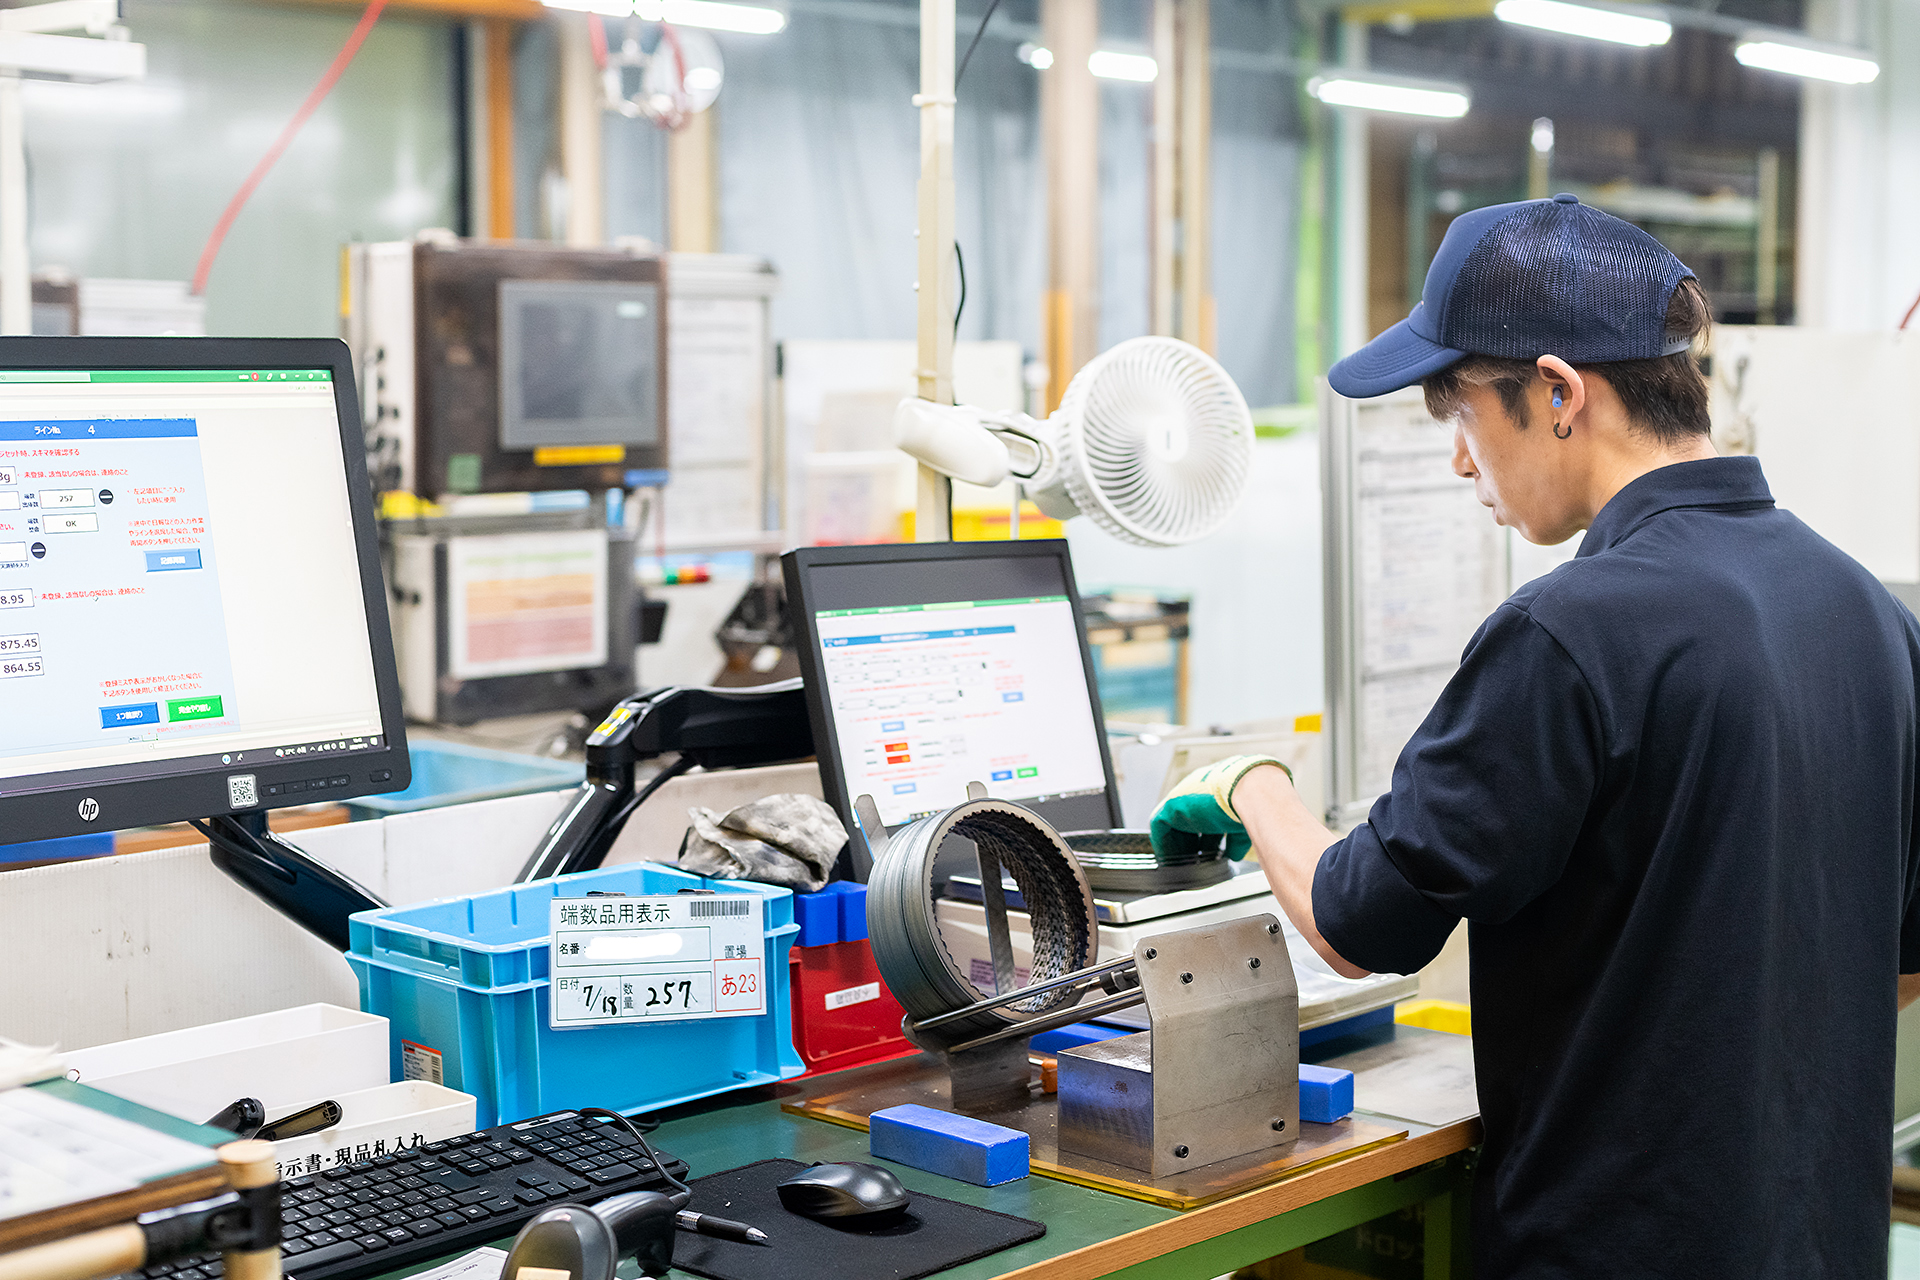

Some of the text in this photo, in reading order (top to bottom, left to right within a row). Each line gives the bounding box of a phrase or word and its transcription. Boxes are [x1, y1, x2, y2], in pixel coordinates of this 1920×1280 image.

[88, 425, 95, 435] 4
[0, 594, 24, 605] 8.95
[0, 638, 38, 650] 875.45
[3, 662, 41, 674] 864.55
[80, 797, 98, 822] hp
[560, 904, 670, 925] 端数品用表示
[724, 945, 747, 959] 置場
[559, 979, 580, 991] 日付
[721, 974, 757, 996] あ23
[583, 985, 617, 1015] 7/18
[645, 980, 692, 1009] 257
